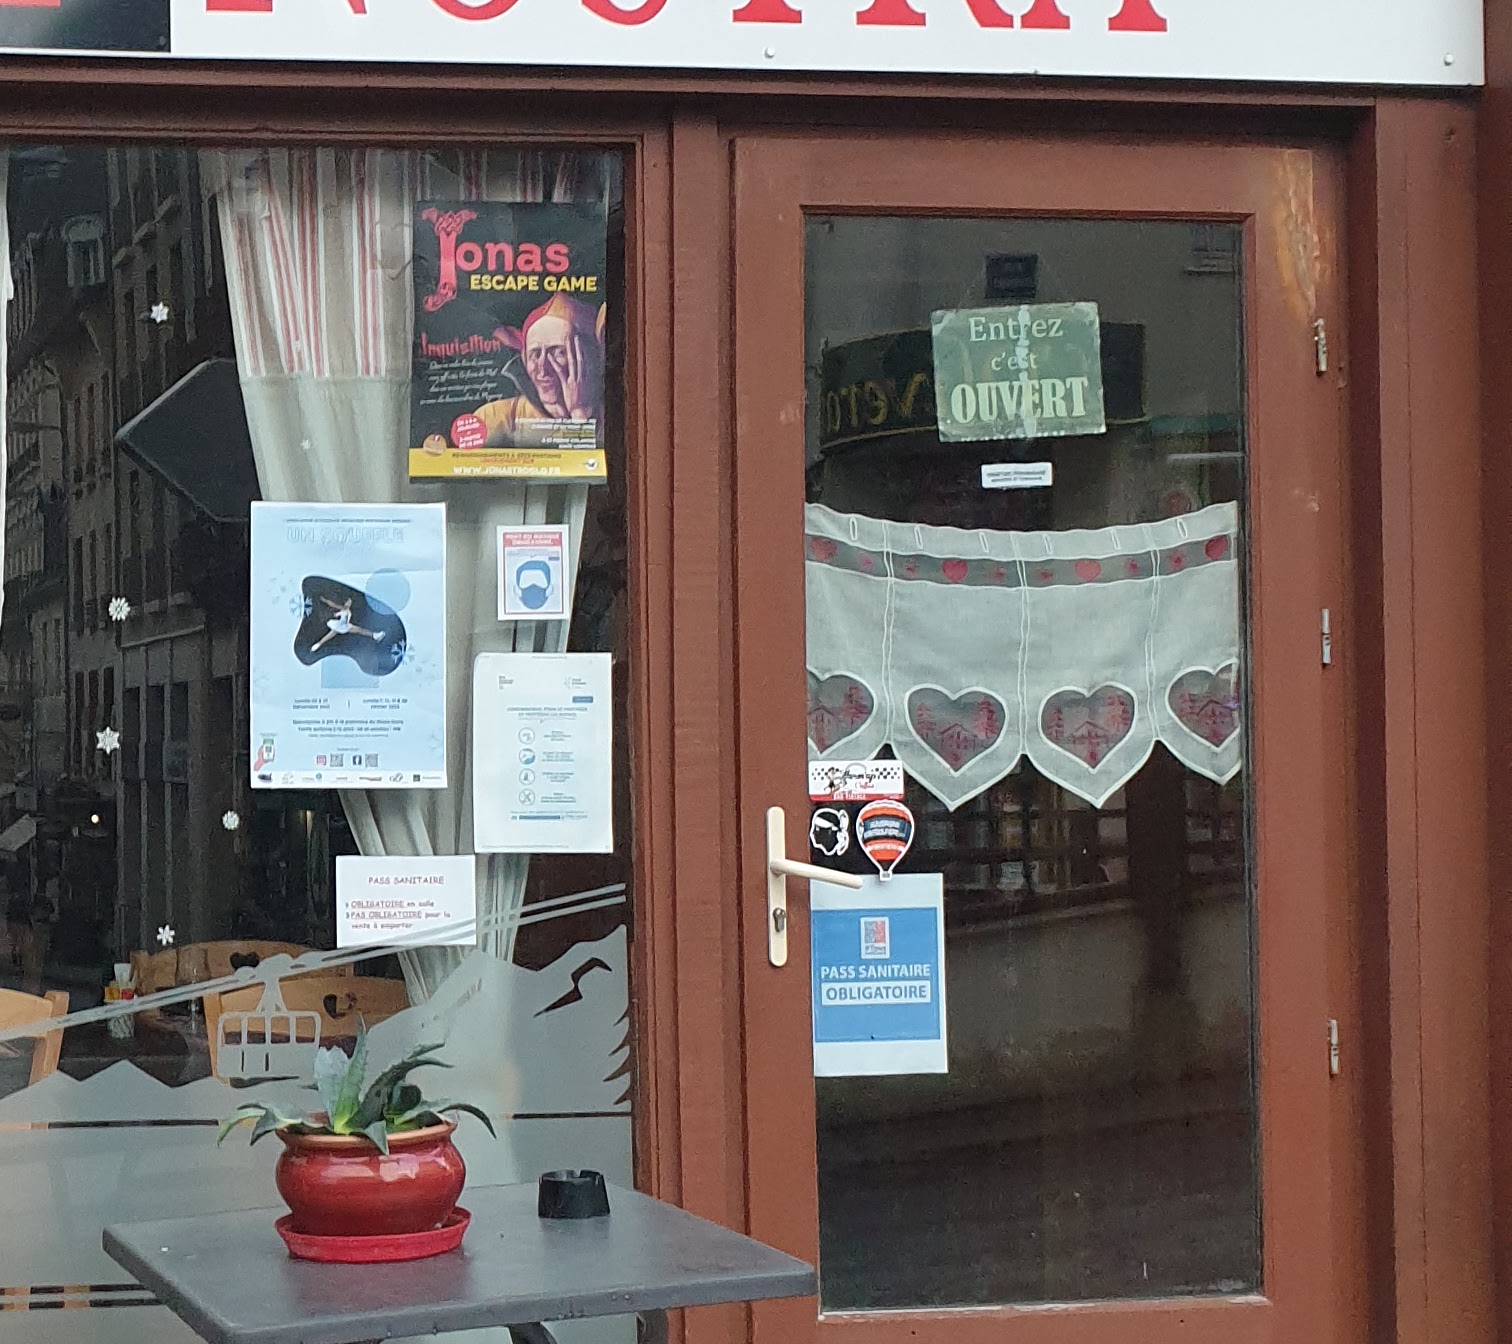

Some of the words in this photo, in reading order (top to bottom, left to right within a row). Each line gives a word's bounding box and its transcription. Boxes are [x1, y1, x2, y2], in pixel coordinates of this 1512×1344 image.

[421, 207, 570, 312] Jonas
[470, 274, 539, 291] ESCAPE
[543, 275, 598, 292] GAME
[968, 316, 1064, 343] Entrez
[950, 376, 1089, 425] OUVERT
[368, 877, 391, 885] PASS
[393, 875, 445, 885] SANITAIRE
[820, 965, 856, 979] PASS
[858, 963, 931, 978] SANITAIRE
[825, 984, 928, 1001] OBLIGATOIRE
